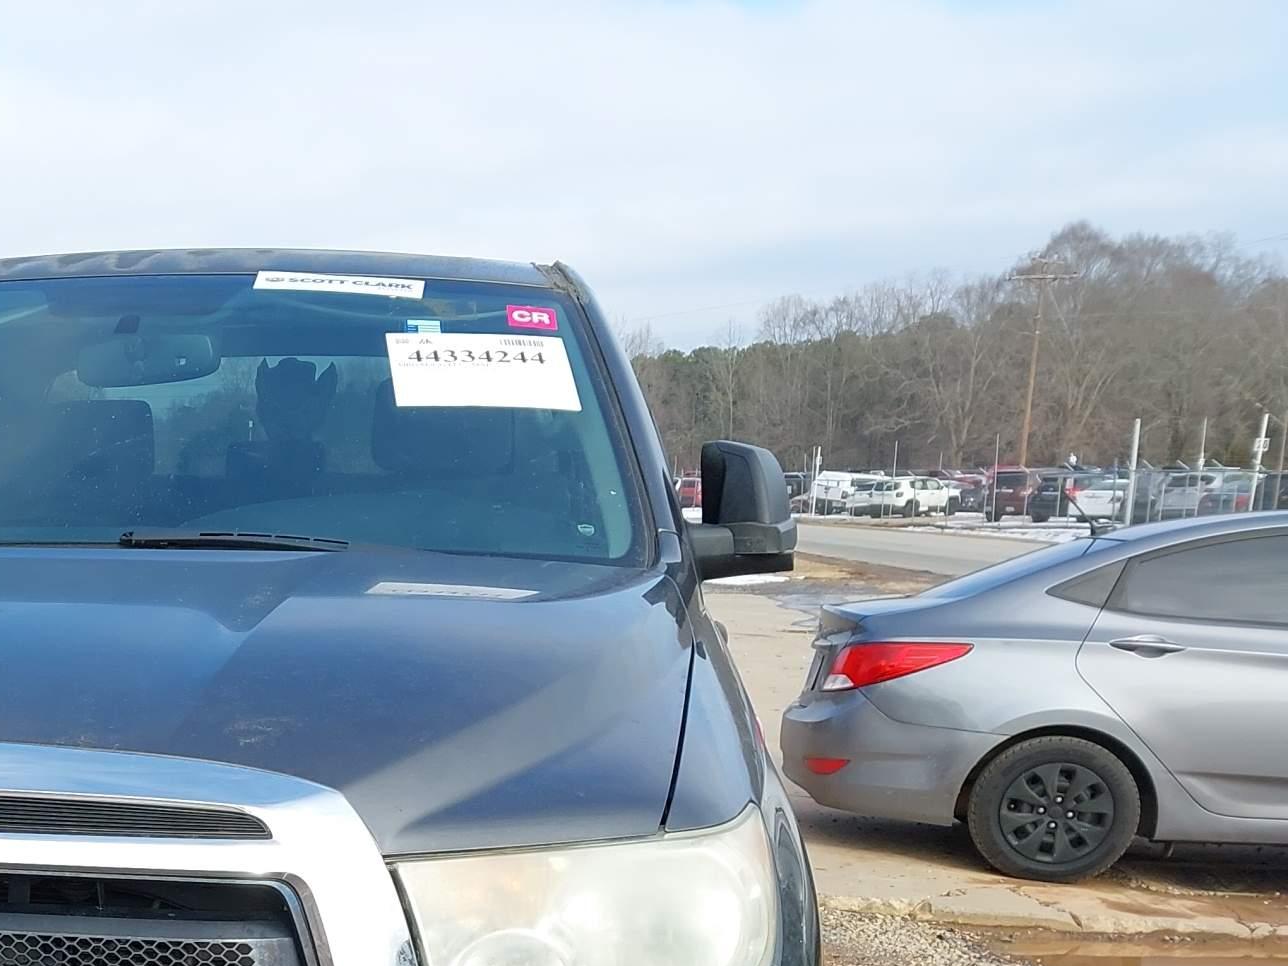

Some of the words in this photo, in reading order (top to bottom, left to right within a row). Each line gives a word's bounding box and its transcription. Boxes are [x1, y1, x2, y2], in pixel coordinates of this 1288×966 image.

[288, 277, 349, 286] SCOTT
[351, 280, 414, 290] CLARK
[511, 309, 551, 325] CR
[407, 348, 547, 365] 44334244
